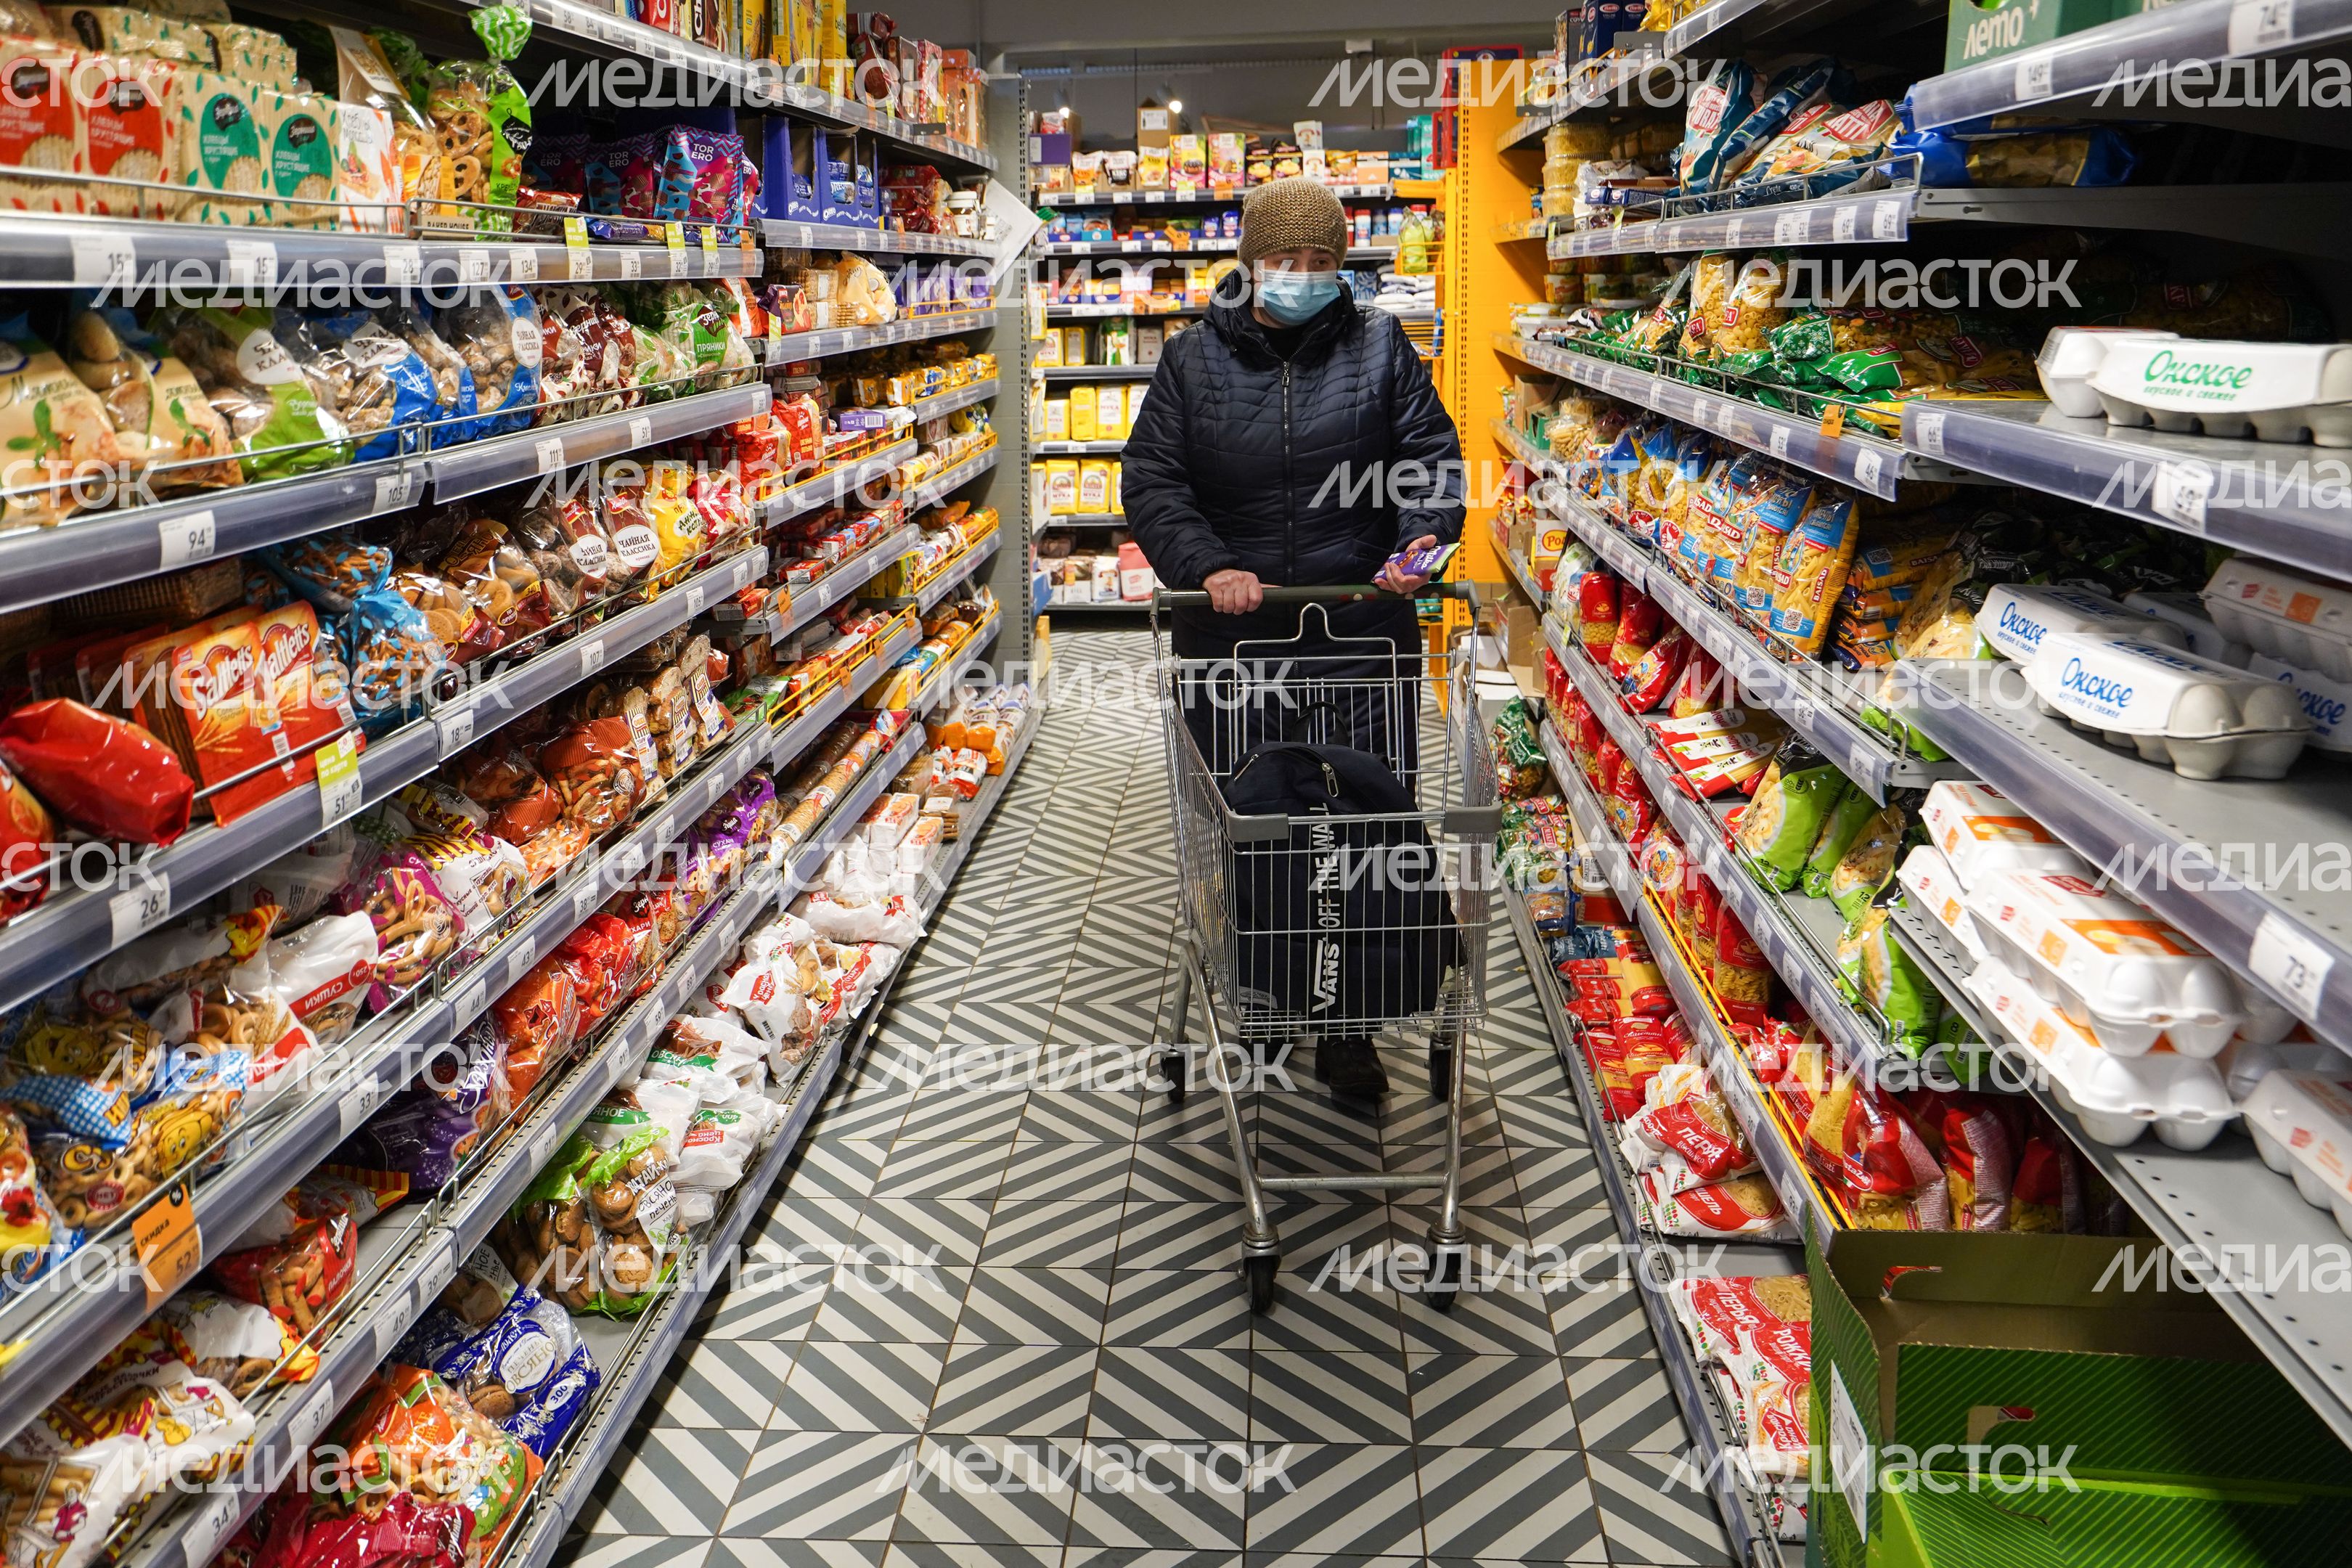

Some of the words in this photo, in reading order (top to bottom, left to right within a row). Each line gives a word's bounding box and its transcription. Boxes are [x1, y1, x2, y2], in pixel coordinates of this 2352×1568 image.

[691, 152, 713, 163] ERO
[693, 144, 714, 155] TOR
[609, 159, 629, 168] ERO
[521, 260, 533, 274] 134
[696, 343, 727, 353] ПРЯНИКИ
[2145, 350, 2253, 389] Окское
[388, 487, 403, 503] 105
[189, 530, 205, 550] 94
[618, 534, 651, 549] ЧАЙНАЯ
[621, 543, 656, 558] КЛАССИКА
[1420, 544, 1438, 571] Milka
[1813, 568, 1829, 603] BAISAD
[2000, 601, 2048, 646] Окское
[192, 643, 254, 721] Saltletts
[2061, 657, 2135, 709] Окское
[452, 728, 461, 743] 18
[335, 798, 346, 815] 51
[1317, 844, 1342, 883] THE
[142, 897, 160, 920] 26
[1318, 883, 1342, 930] OFF
[521, 953, 531, 966] 43
[2285, 954, 2308, 987] 73
[1313, 939, 1342, 1011] VANS
[304, 981, 343, 1008] СУШКИ
[590, 1105, 625, 1119] ЯНОЕ
[139, 1217, 171, 1246] скидка
[327, 1260, 353, 1292] ПАЛОЧКИ
[1716, 1291, 1759, 1326] ПЕРЬЯ
[549, 1383, 568, 1405] 300
[312, 1403, 327, 1428] 37
